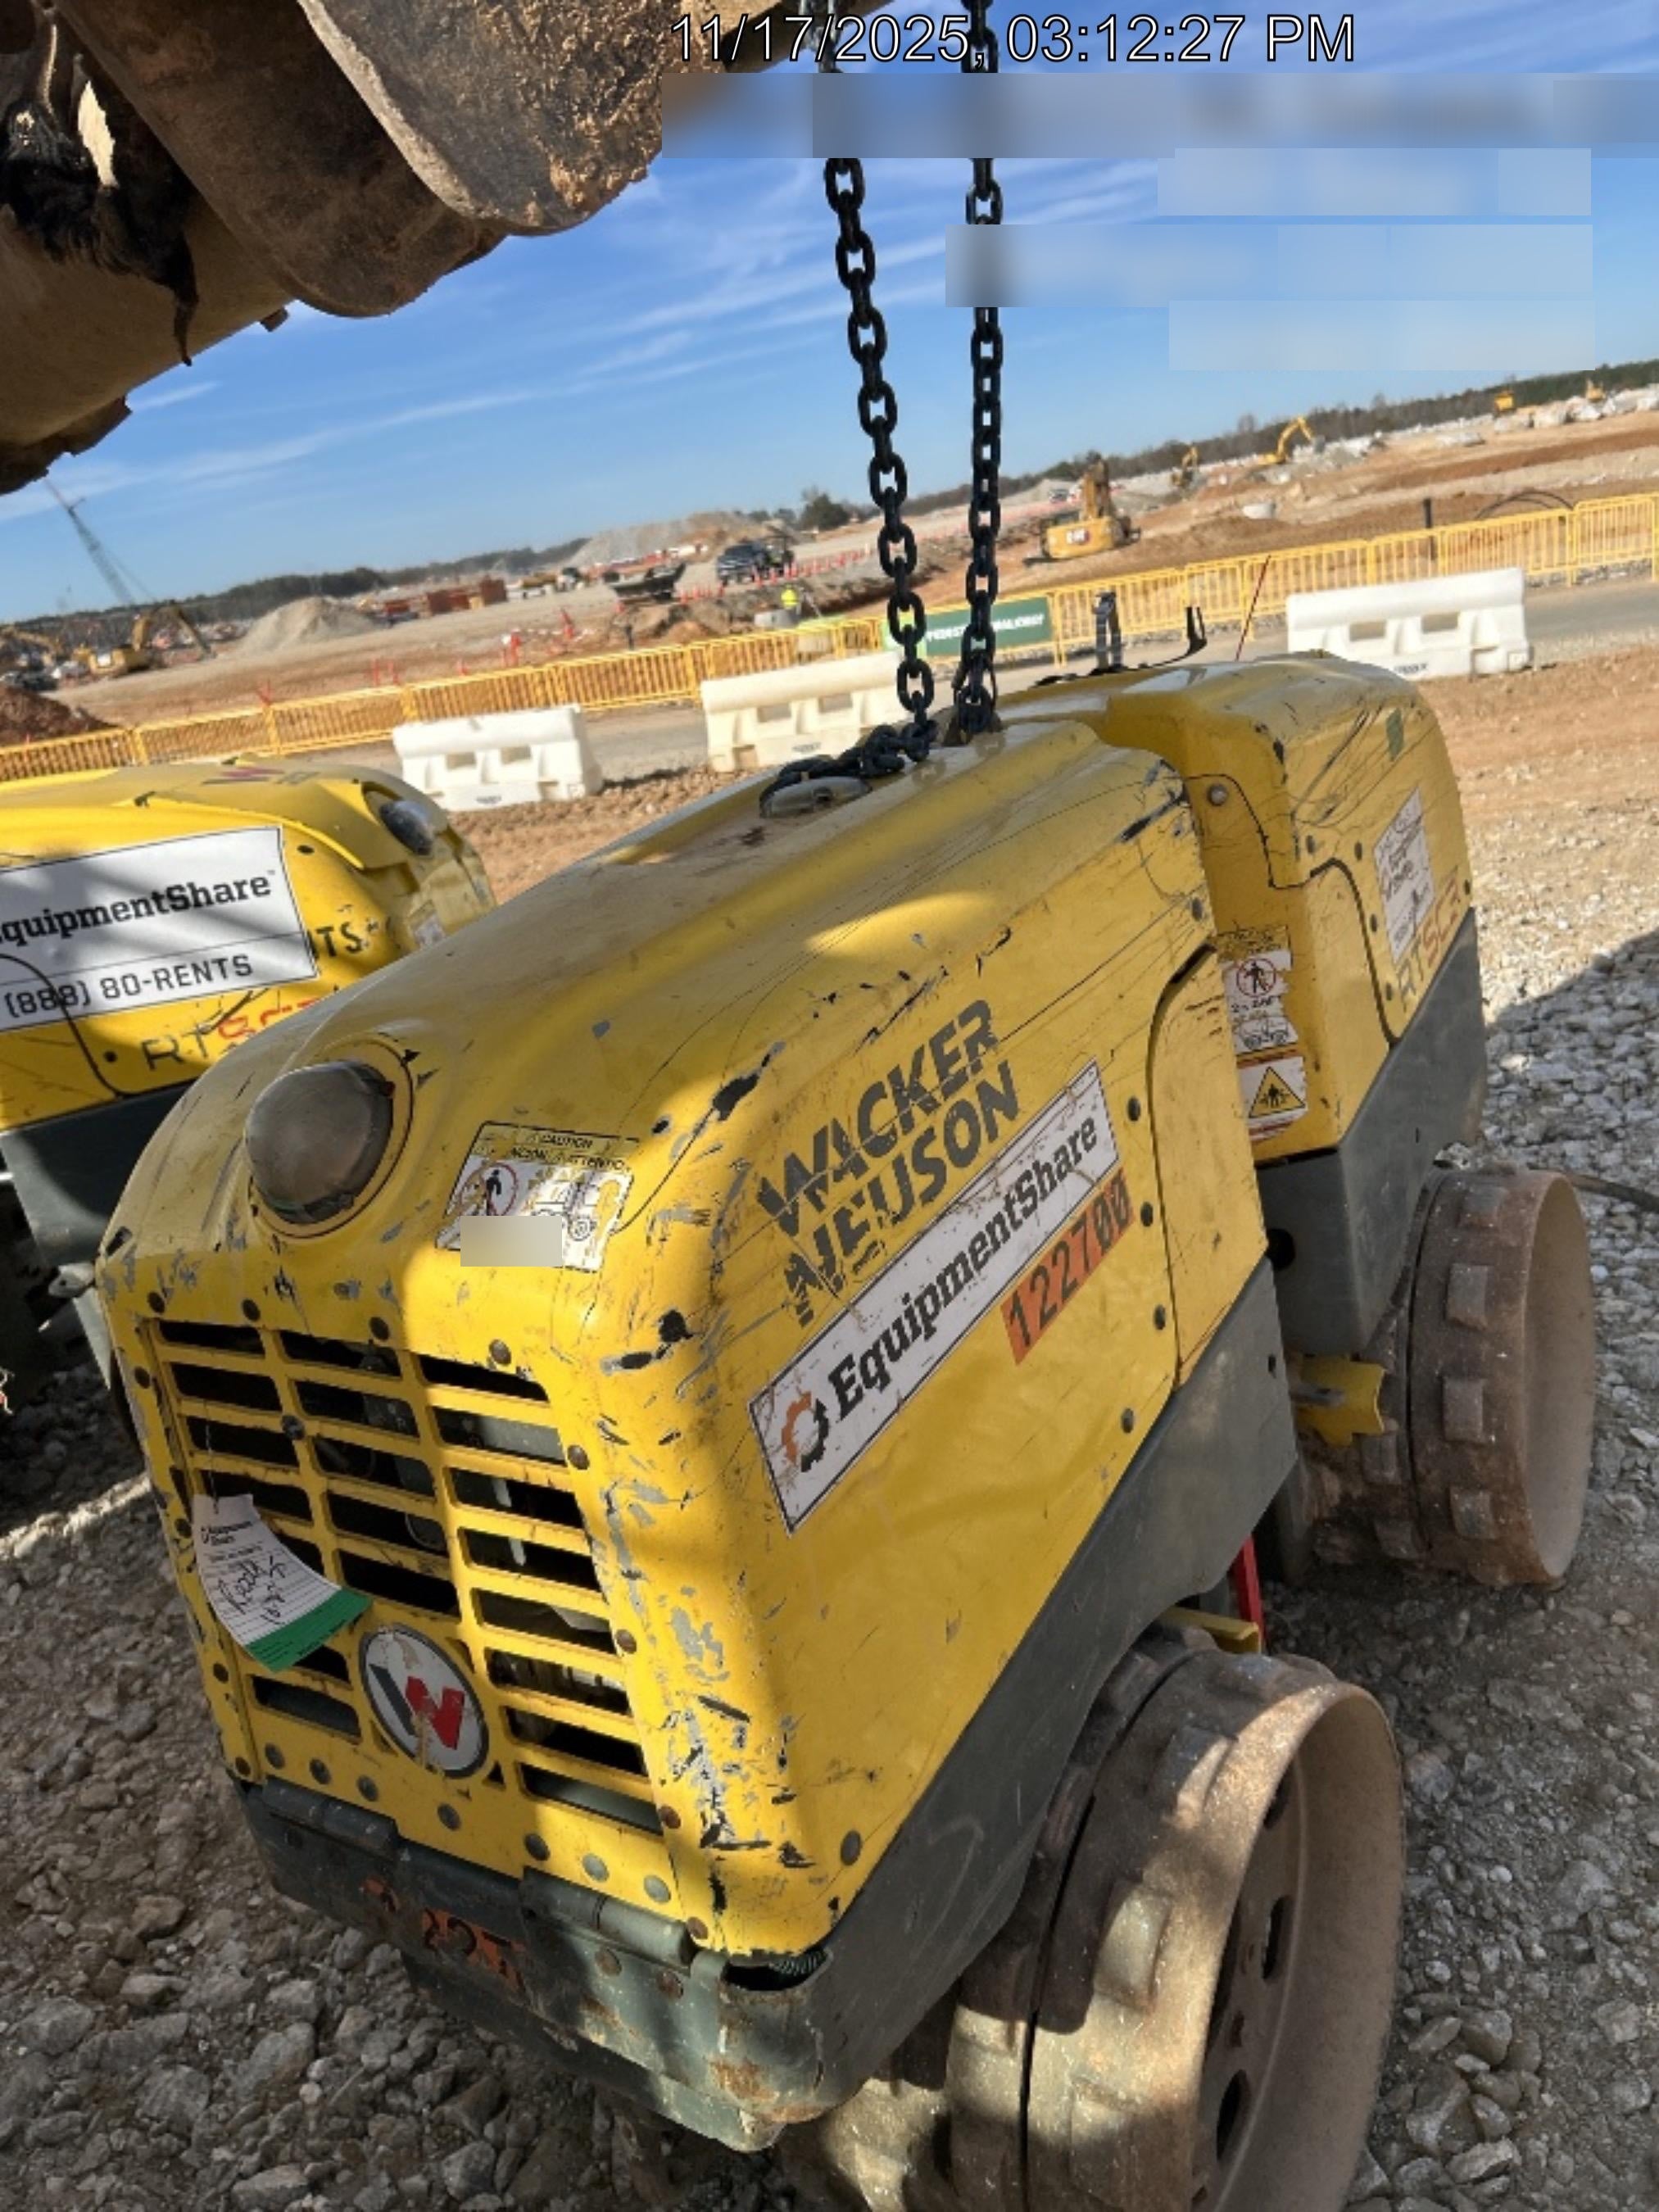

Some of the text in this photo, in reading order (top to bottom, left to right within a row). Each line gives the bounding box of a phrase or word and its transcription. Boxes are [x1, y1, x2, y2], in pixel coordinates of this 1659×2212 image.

[0, 875, 272, 947] quipmentShare
[5, 953, 254, 1018] (888) 80-RENTS
[757, 999, 999, 1236] WACKER
[783, 1060, 1019, 1327] NEUSON
[828, 1117, 1097, 1420] EquipmentShare
